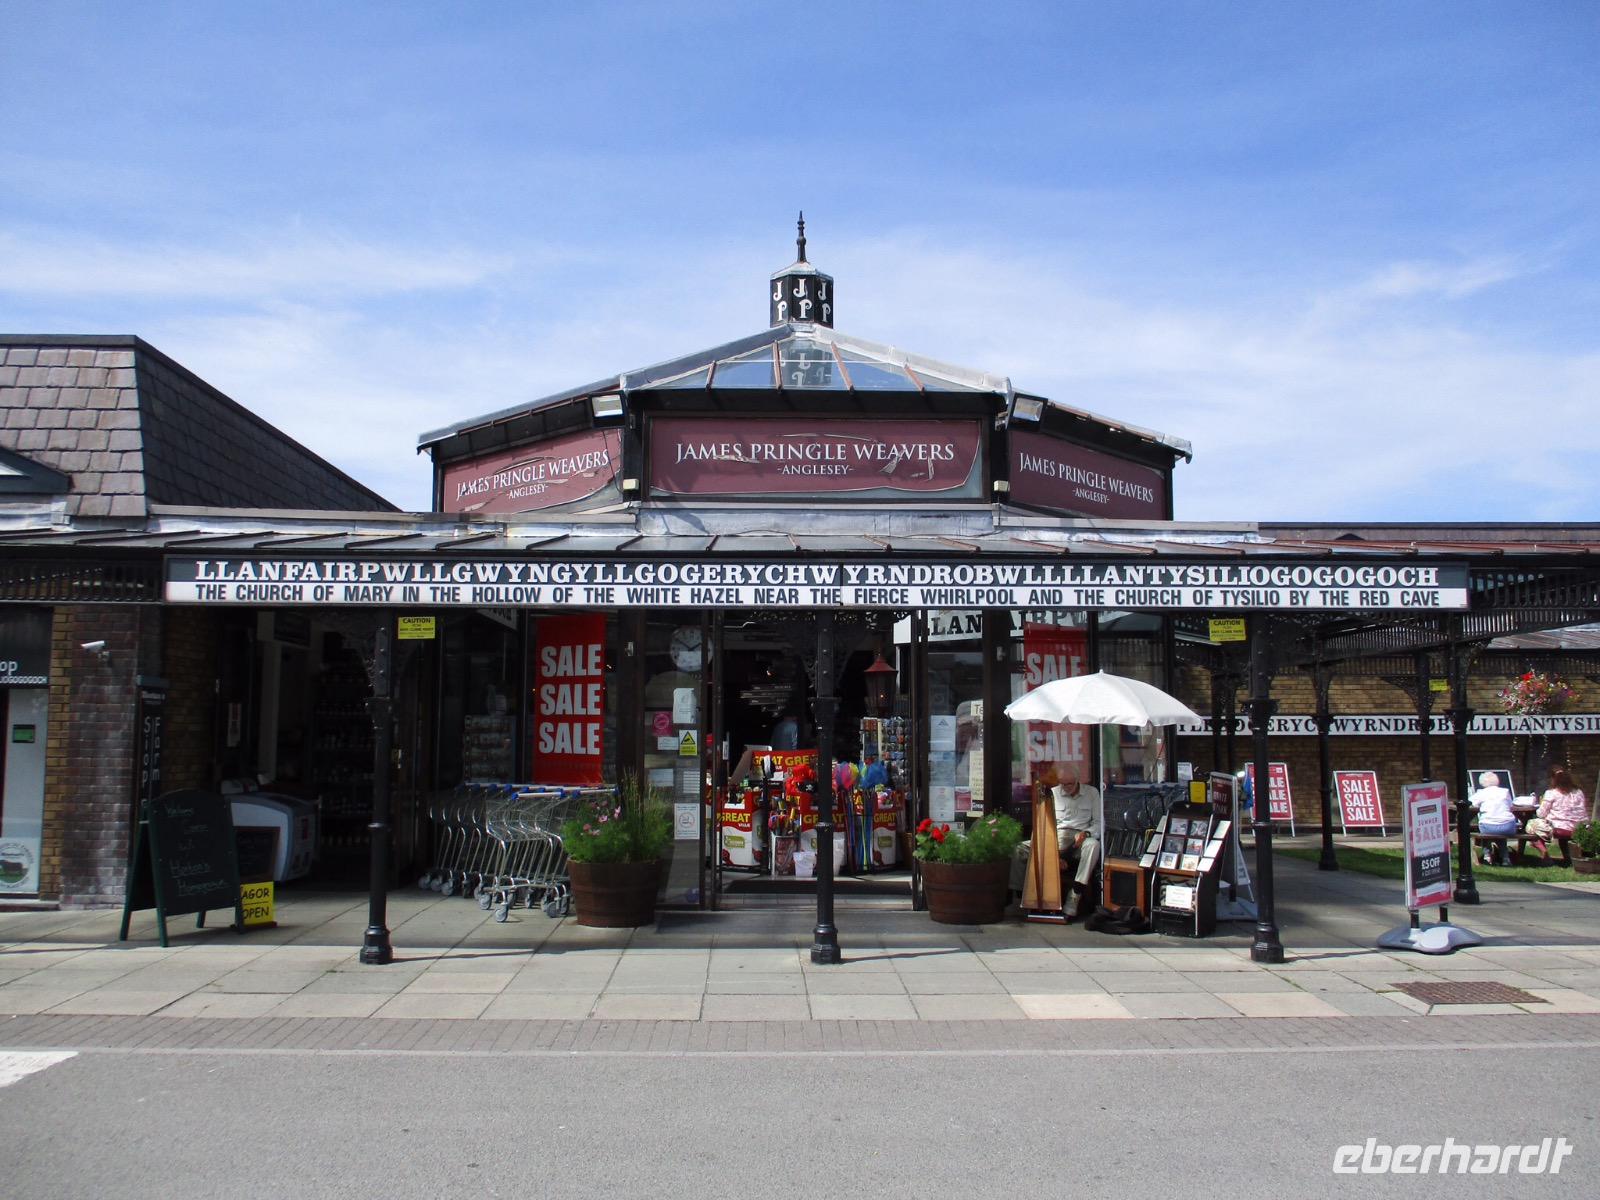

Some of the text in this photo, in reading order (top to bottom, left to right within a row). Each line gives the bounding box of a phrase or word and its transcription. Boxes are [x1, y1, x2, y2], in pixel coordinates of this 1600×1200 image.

[675, 443, 954, 464] JAMES PRINGLE WEAVERS
[456, 449, 609, 501] JAMES PRINGLE WEAVERS
[1019, 452, 1154, 503] JAMES PRINGLE WEAVERS
[195, 584, 1440, 606] THE CHURCH OF MARY IN THE HOLLOW OF THE WHITE HAZEL NEAR THE FIERCE WHIRLPOOL AND THE CHURCH OF TYSILIO BY THE RED CAVE
[541, 644, 602, 678] SALE
[1027, 651, 1081, 685] SALE
[540, 683, 601, 716] SALE
[539, 721, 600, 755] SALE
[1029, 730, 1084, 763] SALE
[1341, 779, 1372, 793] SALE
[1344, 793, 1374, 807] SALE
[873, 811, 897, 823] GREAT
[1347, 807, 1377, 821] SALE
[1415, 824, 1443, 843] SALE
[1429, 856, 1441, 868] OFF
[241, 887, 270, 900] AGOR
[242, 906, 269, 920] OPEN
